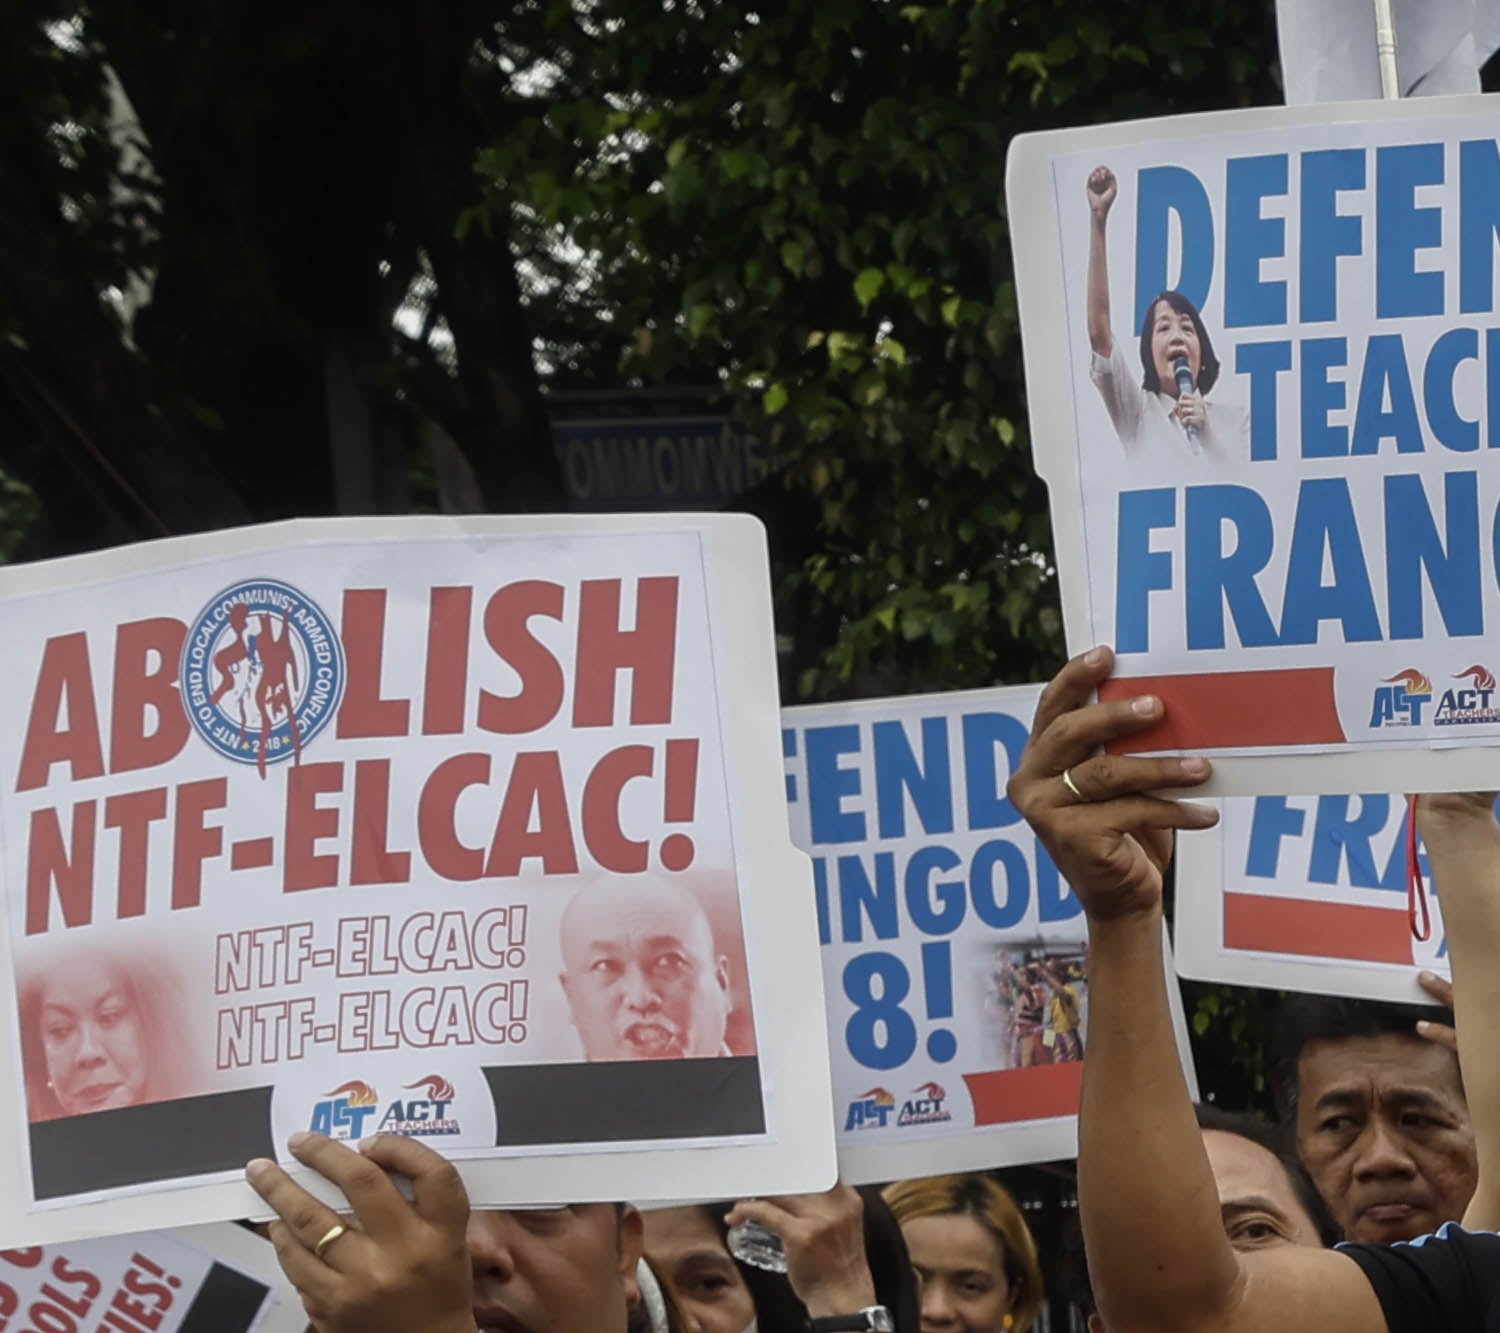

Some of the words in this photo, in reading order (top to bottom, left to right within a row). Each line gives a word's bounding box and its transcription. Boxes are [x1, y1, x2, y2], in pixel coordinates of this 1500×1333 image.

[191, 618, 219, 671] LOCAL
[294, 608, 331, 665] ARMED
[15, 576, 680, 793] ABLISH
[189, 672, 207, 707] END
[296, 668, 333, 734] CONFLIC
[1435, 688, 1496, 719] ACT
[200, 706, 214, 730] TO
[214, 725, 241, 749] NTF
[252, 737, 281, 754] 218
[25, 738, 701, 936] NTF-ELCAC!
[214, 905, 527, 995] NTF-ELCAC!
[215, 980, 528, 1070] NTF-ELCAC!
[378, 1098, 453, 1130] ACT
[897, 1099, 945, 1124] ACT
